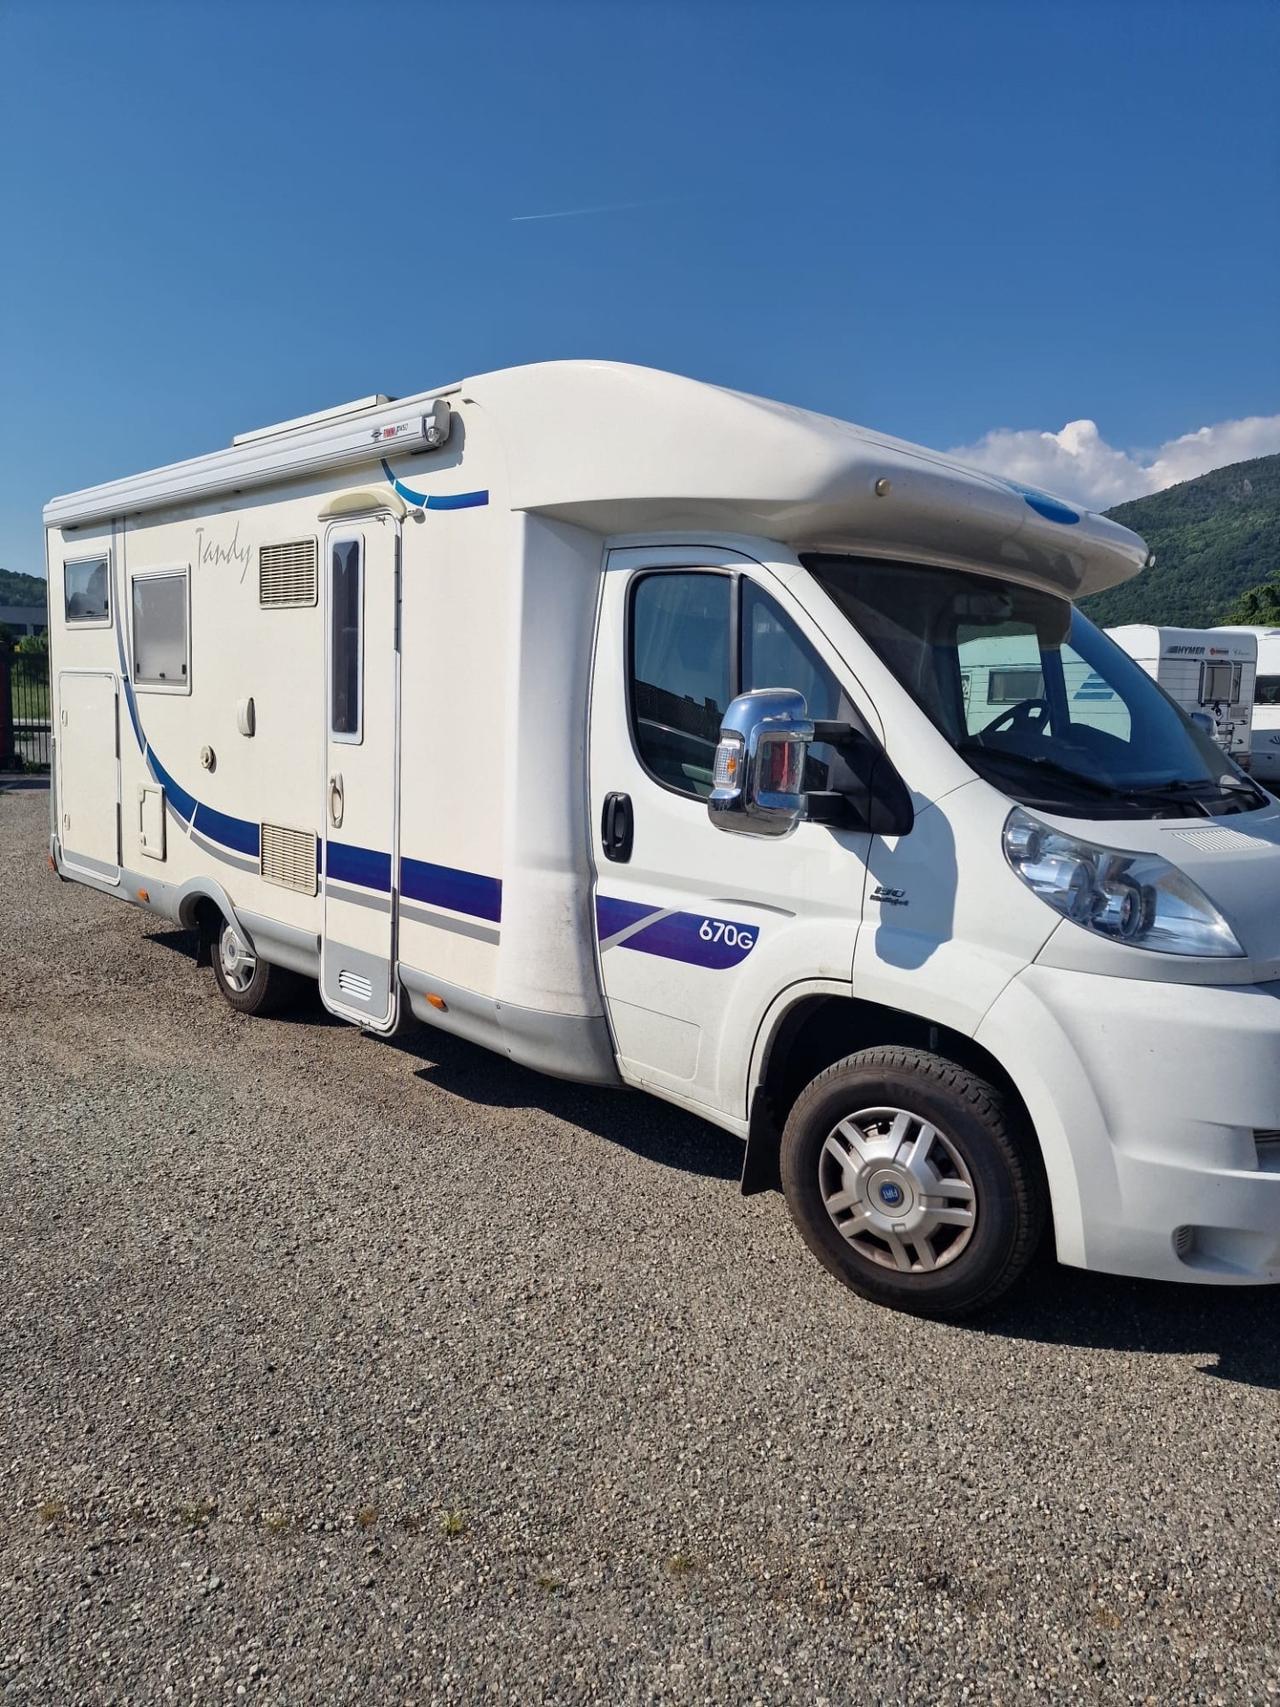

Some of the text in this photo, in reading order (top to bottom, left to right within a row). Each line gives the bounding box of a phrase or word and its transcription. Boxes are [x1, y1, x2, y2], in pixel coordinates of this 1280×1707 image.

[195, 520, 252, 584] Tandy
[1177, 645, 1206, 656] HYMER
[699, 919, 754, 950] 670G
